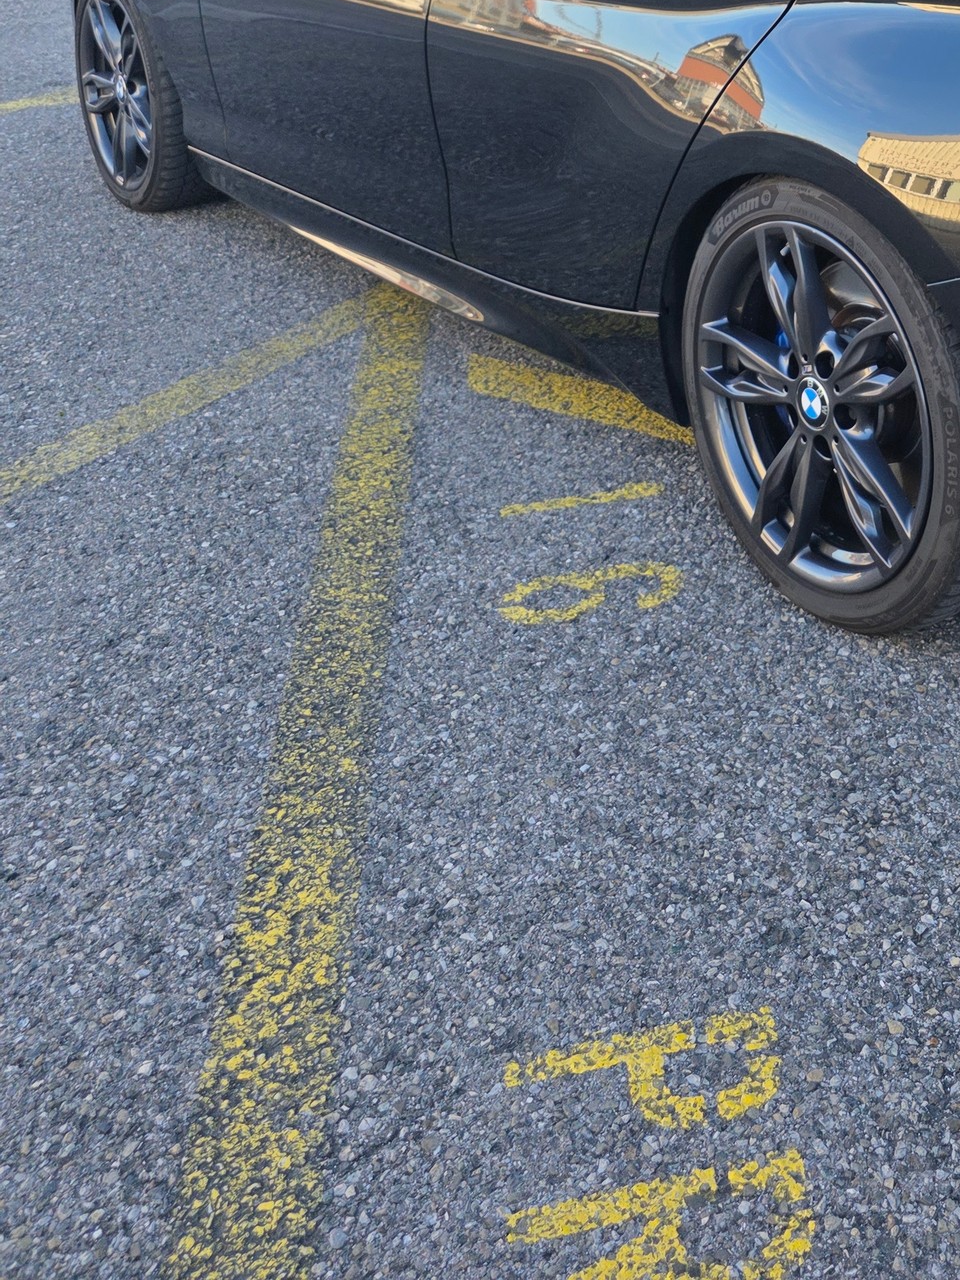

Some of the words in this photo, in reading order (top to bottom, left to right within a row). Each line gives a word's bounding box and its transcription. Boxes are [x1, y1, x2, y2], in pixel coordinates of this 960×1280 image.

[711, 195, 760, 237] Barum
[943, 406, 959, 499] POLARIS
[944, 504, 955, 515] 6
